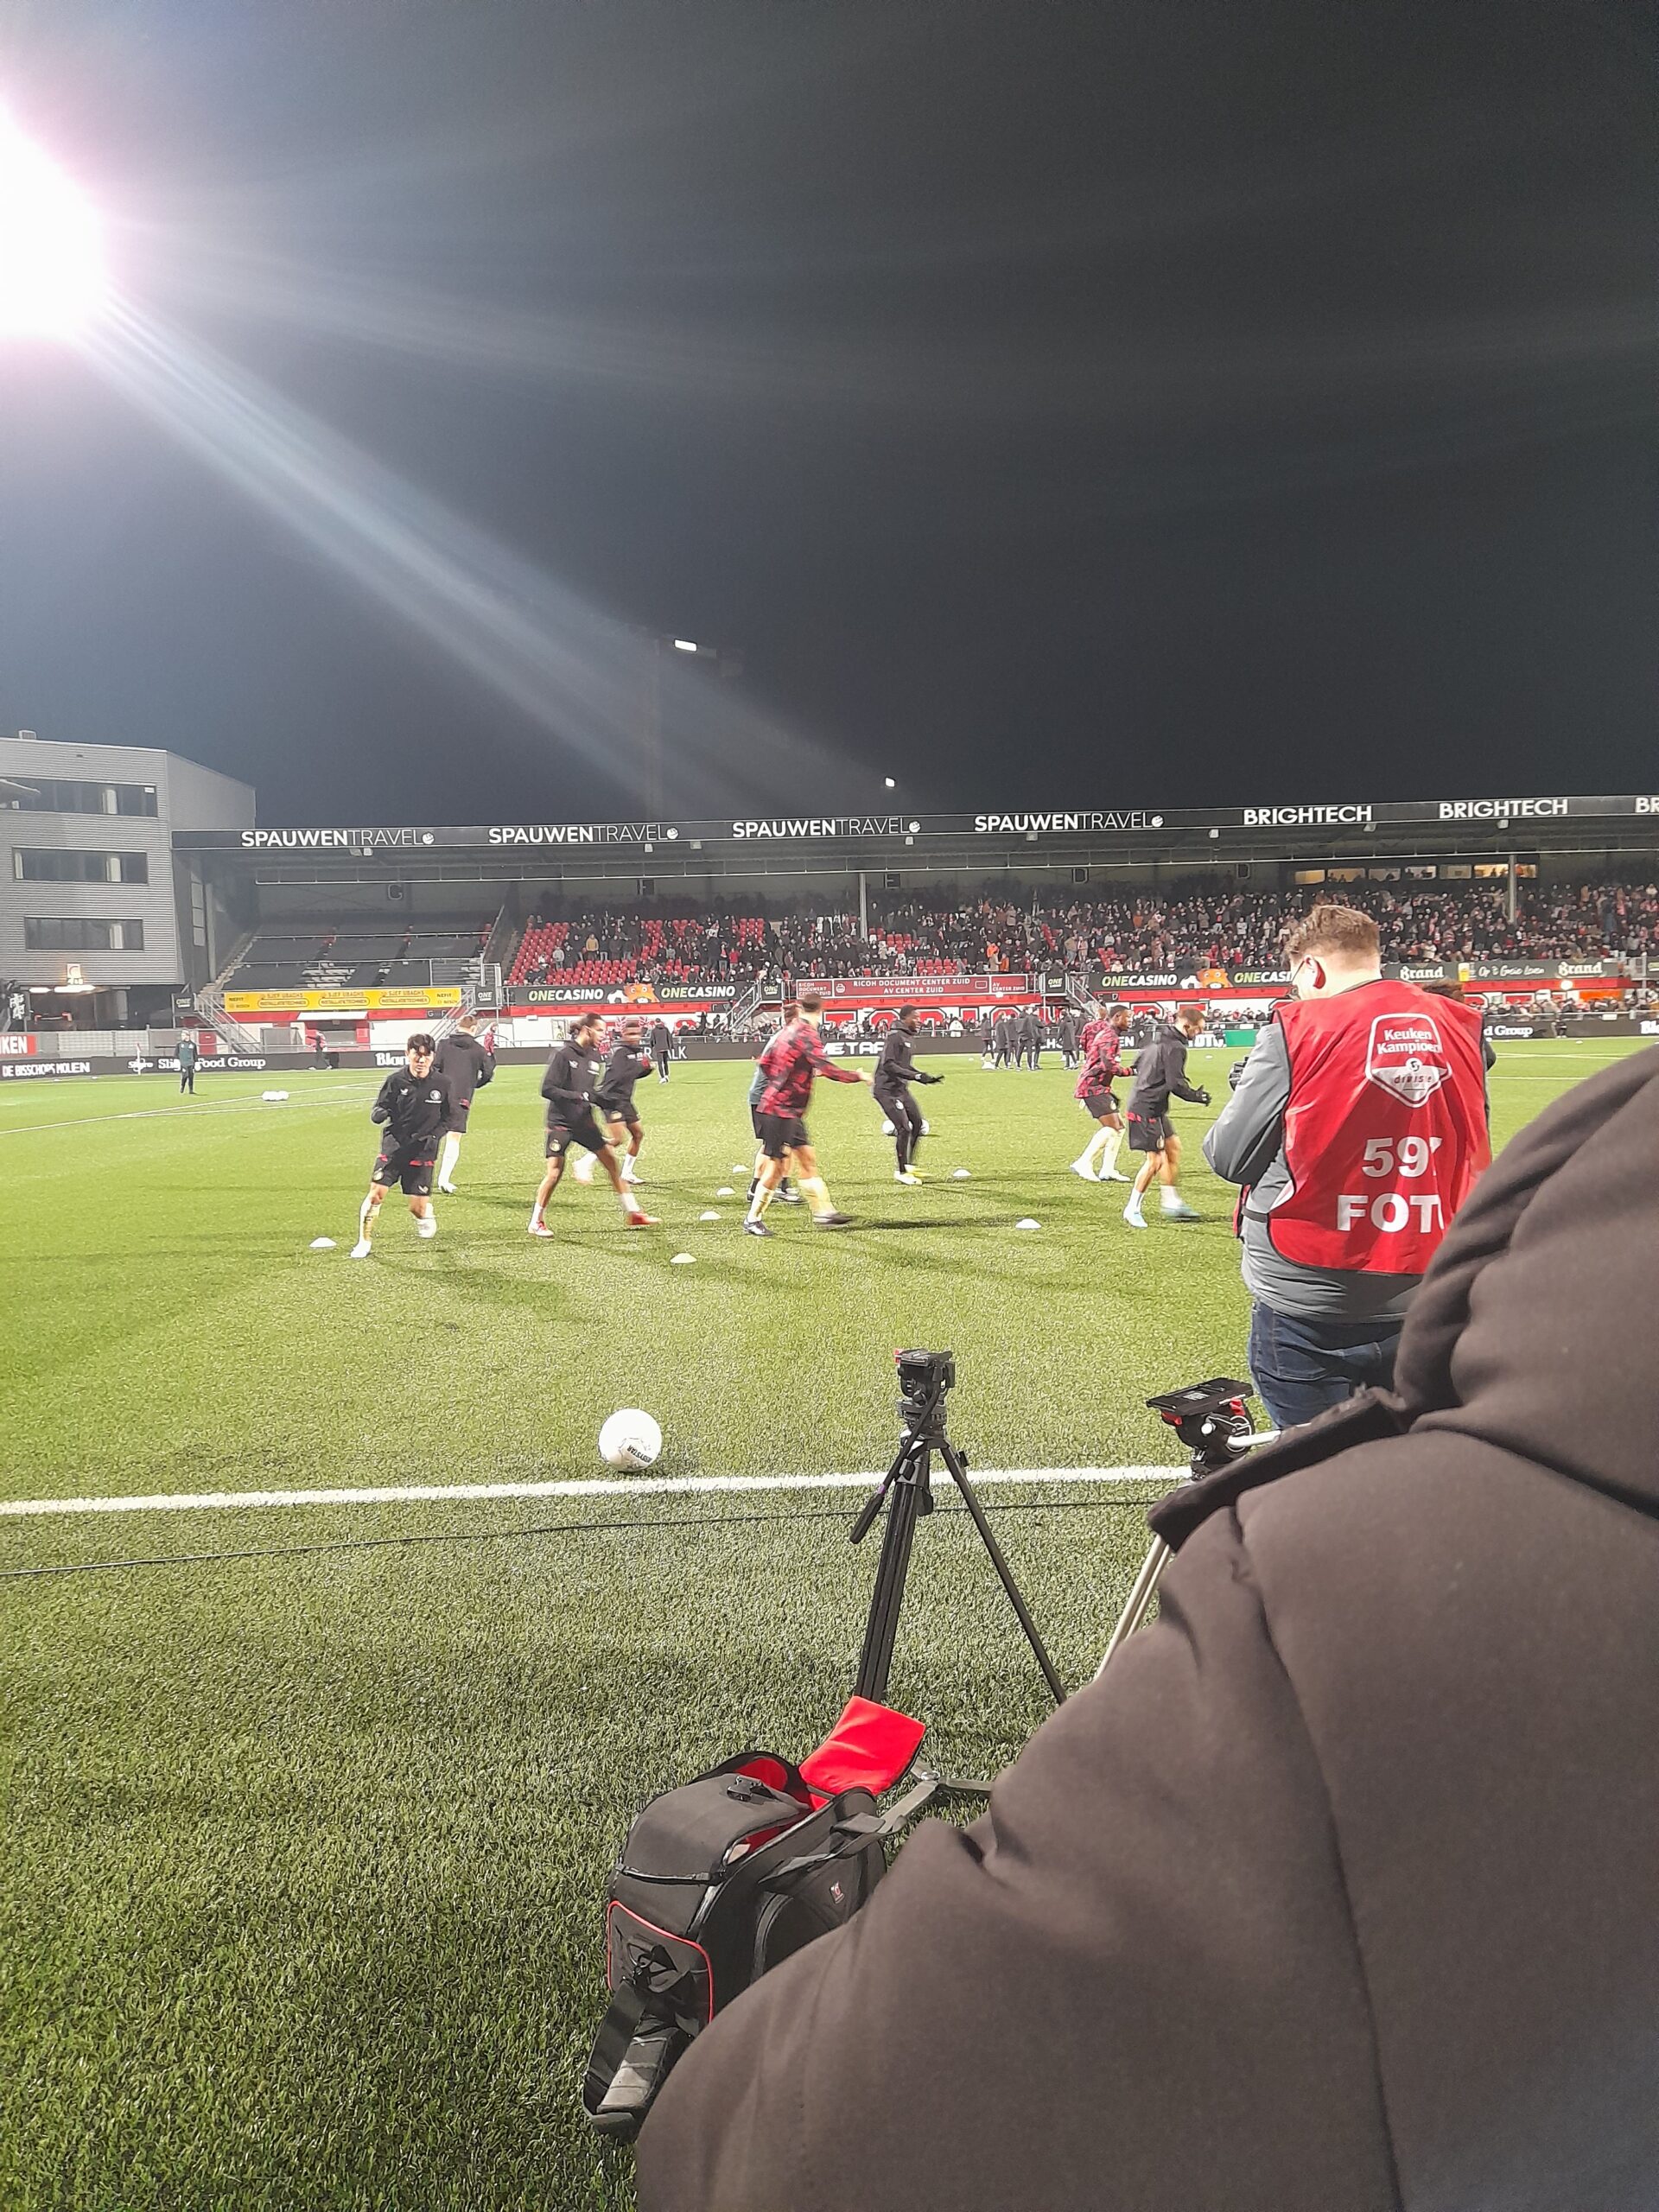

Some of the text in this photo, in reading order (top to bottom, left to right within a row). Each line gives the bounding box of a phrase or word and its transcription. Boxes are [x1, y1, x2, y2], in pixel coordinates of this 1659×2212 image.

[1244, 805, 1372, 825] BRIGHTECH
[1440, 798, 1568, 818] BRIGHTECH
[1400, 965, 1444, 981] Brand
[1558, 961, 1603, 977] Brand
[1102, 974, 1178, 988] ONECASINO
[528, 988, 604, 1002] ONECASINO
[661, 985, 736, 999] ONECASINO
[1383, 1027, 1433, 1041] Keuken
[227, 1057, 266, 1070] Group
[2, 1065, 15, 1077] DE
